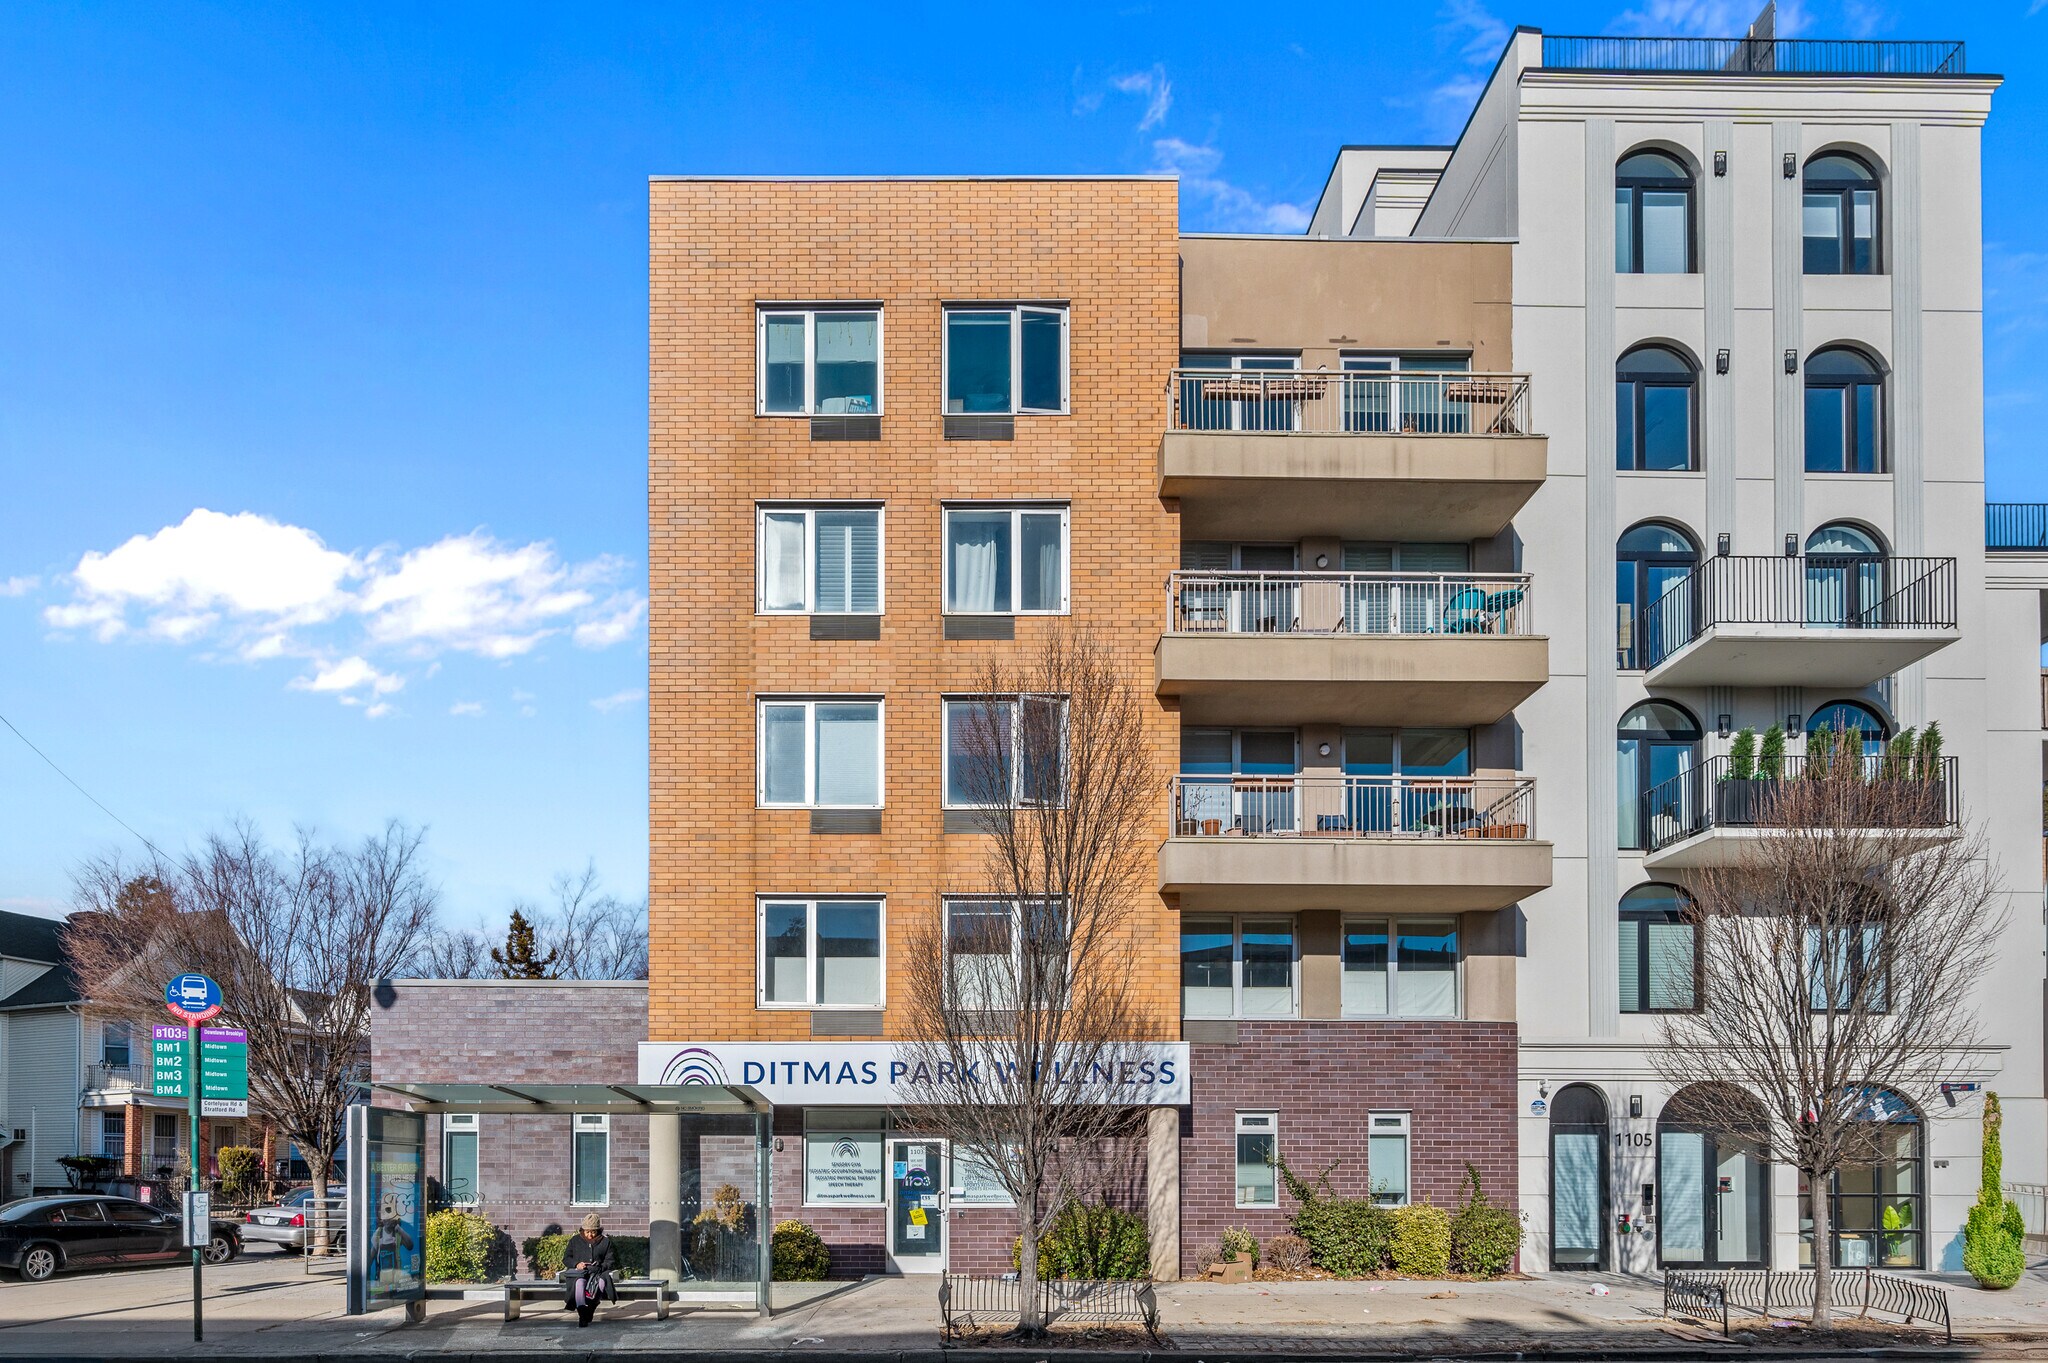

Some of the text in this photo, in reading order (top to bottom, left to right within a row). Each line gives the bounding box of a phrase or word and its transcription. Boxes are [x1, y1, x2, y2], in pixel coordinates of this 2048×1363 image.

[171, 1006, 217, 1020] NO STANDING
[156, 1027, 182, 1038] B103
[226, 1030, 244, 1038] Brooklyn
[156, 1042, 180, 1052] BM1
[156, 1056, 182, 1066] BM2
[156, 1070, 182, 1081] BM3
[743, 1061, 878, 1085] DITMAS
[890, 1061, 981, 1085] PARK
[156, 1084, 182, 1095] BM4
[1615, 1133, 1653, 1147] 1105
